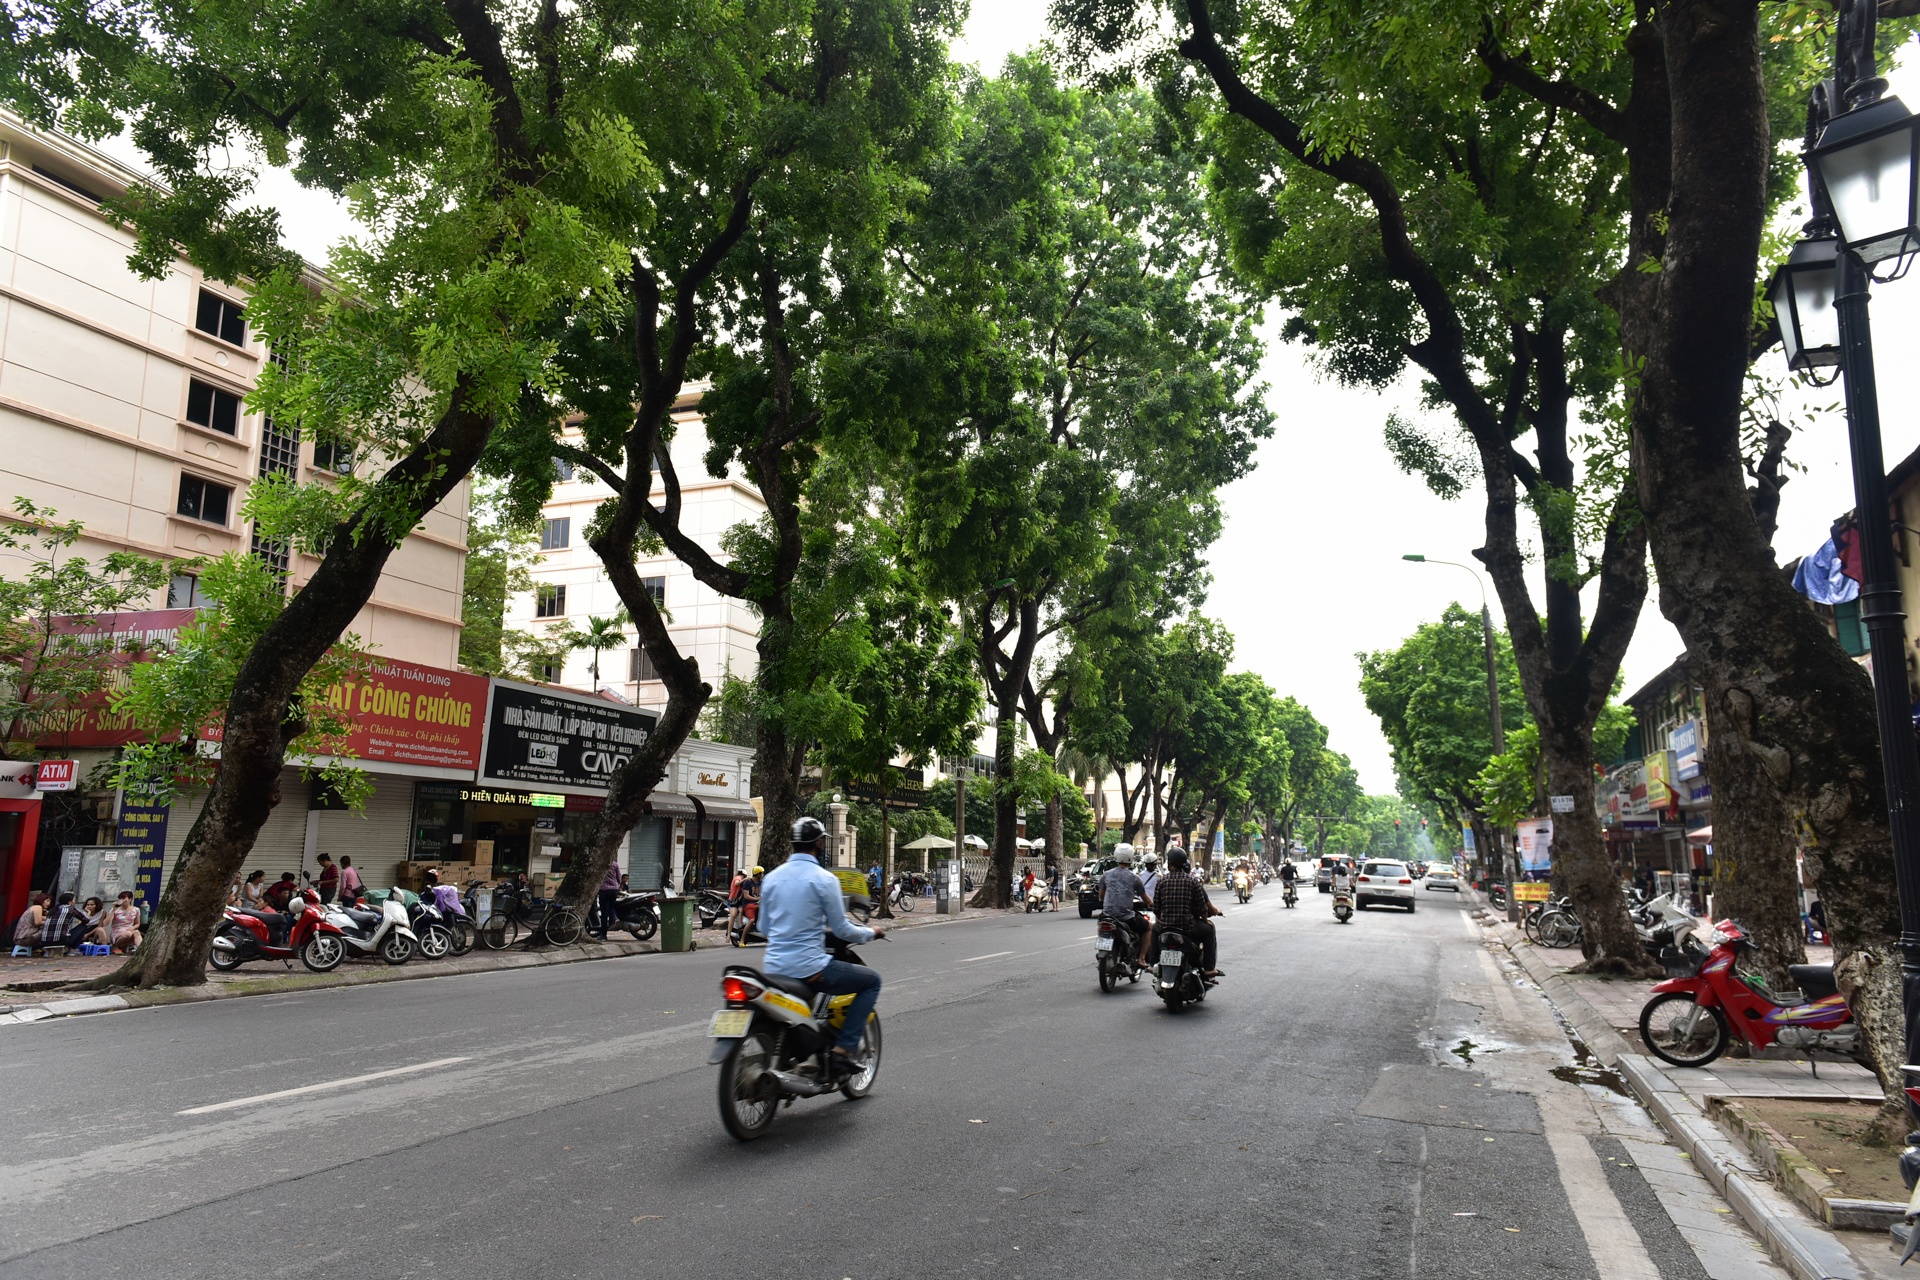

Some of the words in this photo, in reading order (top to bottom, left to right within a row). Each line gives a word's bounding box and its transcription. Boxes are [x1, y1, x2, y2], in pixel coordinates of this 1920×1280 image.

[402, 666, 424, 682] TUẤN
[426, 673, 451, 687] DUNG
[359, 682, 411, 719] CÔNG
[415, 691, 472, 728] CHỨNG
[563, 702, 577, 711] TNHH
[504, 705, 522, 726] NHÀ
[524, 706, 541, 730] SẢN
[564, 712, 580, 736] LẮP
[580, 717, 595, 739] RÁP
[624, 727, 648, 748] NGHIỆP
[518, 730, 530, 739] ĐÈN
[530, 732, 540, 741] LED
[369, 737, 395, 749] Website:
[582, 740, 593, 749] LOA
[368, 747, 386, 757] Email
[40, 764, 68, 778] ATM
[471, 790, 491, 802] HIỀN
[493, 792, 516, 804] QUÂN
